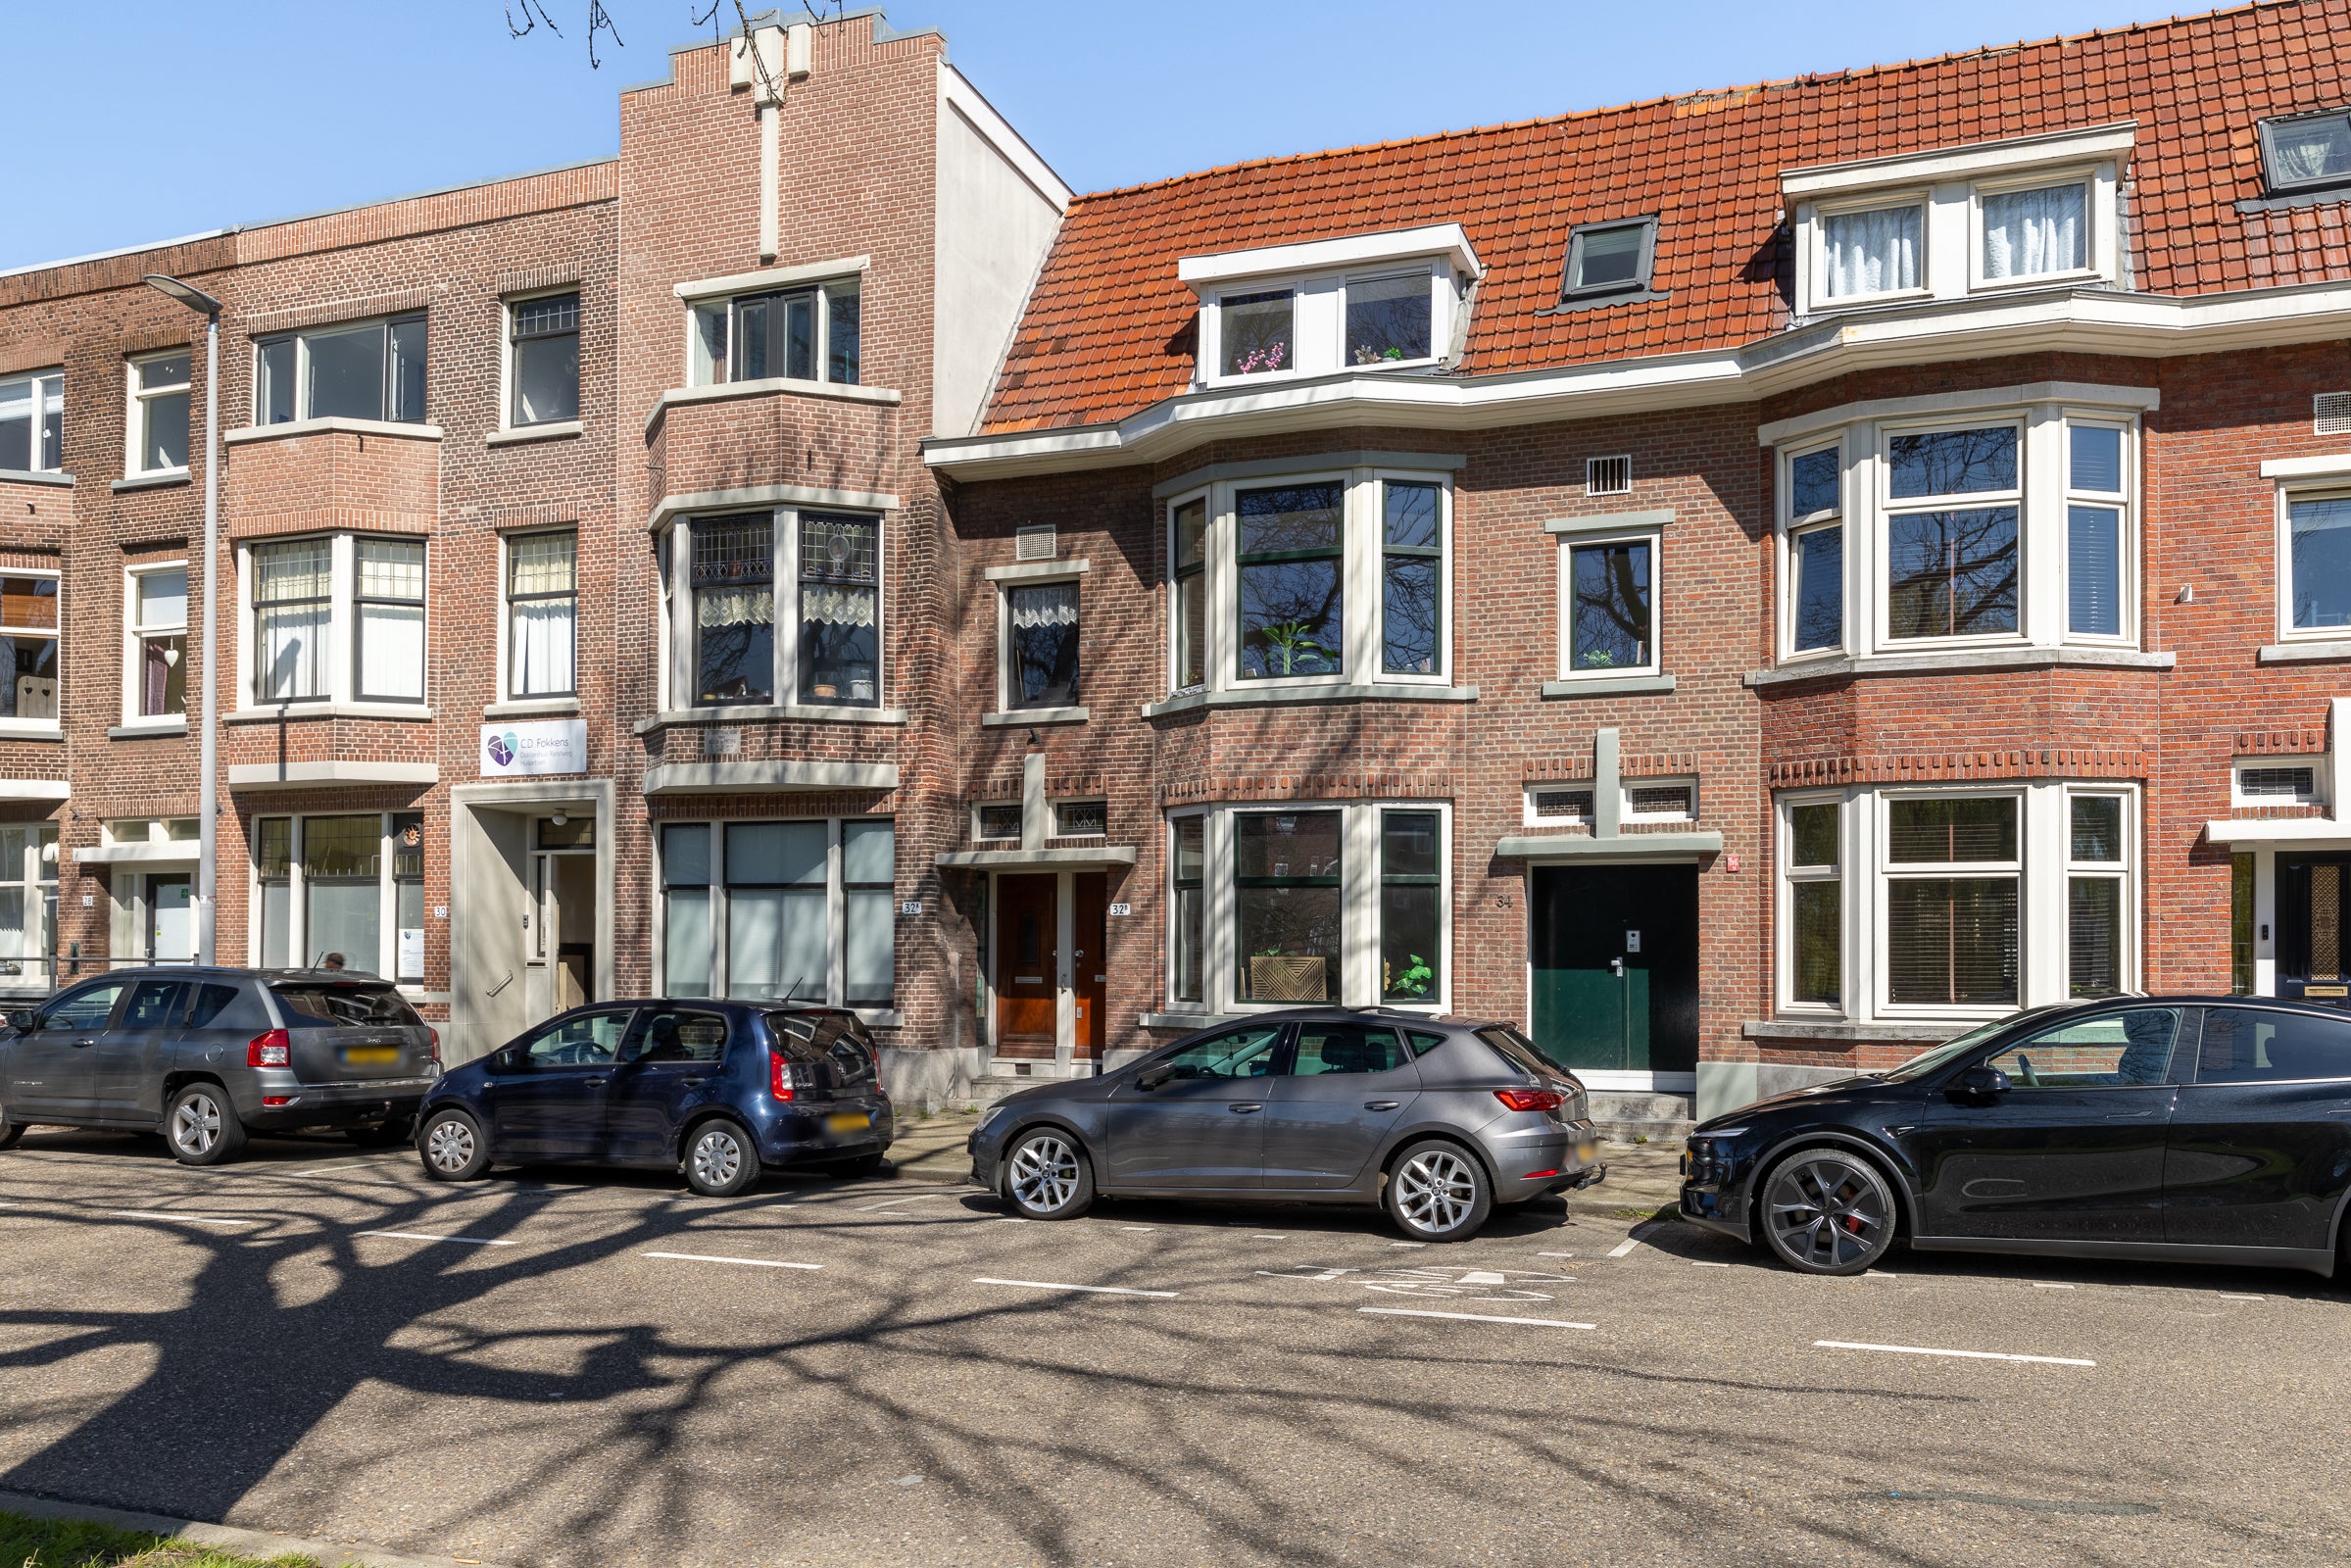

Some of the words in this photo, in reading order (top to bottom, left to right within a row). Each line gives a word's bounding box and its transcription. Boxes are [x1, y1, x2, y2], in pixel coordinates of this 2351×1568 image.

[537, 737, 569, 748] Fokkens
[84, 897, 92, 906] 28
[1495, 895, 1514, 908] 34
[436, 906, 446, 916] 30
